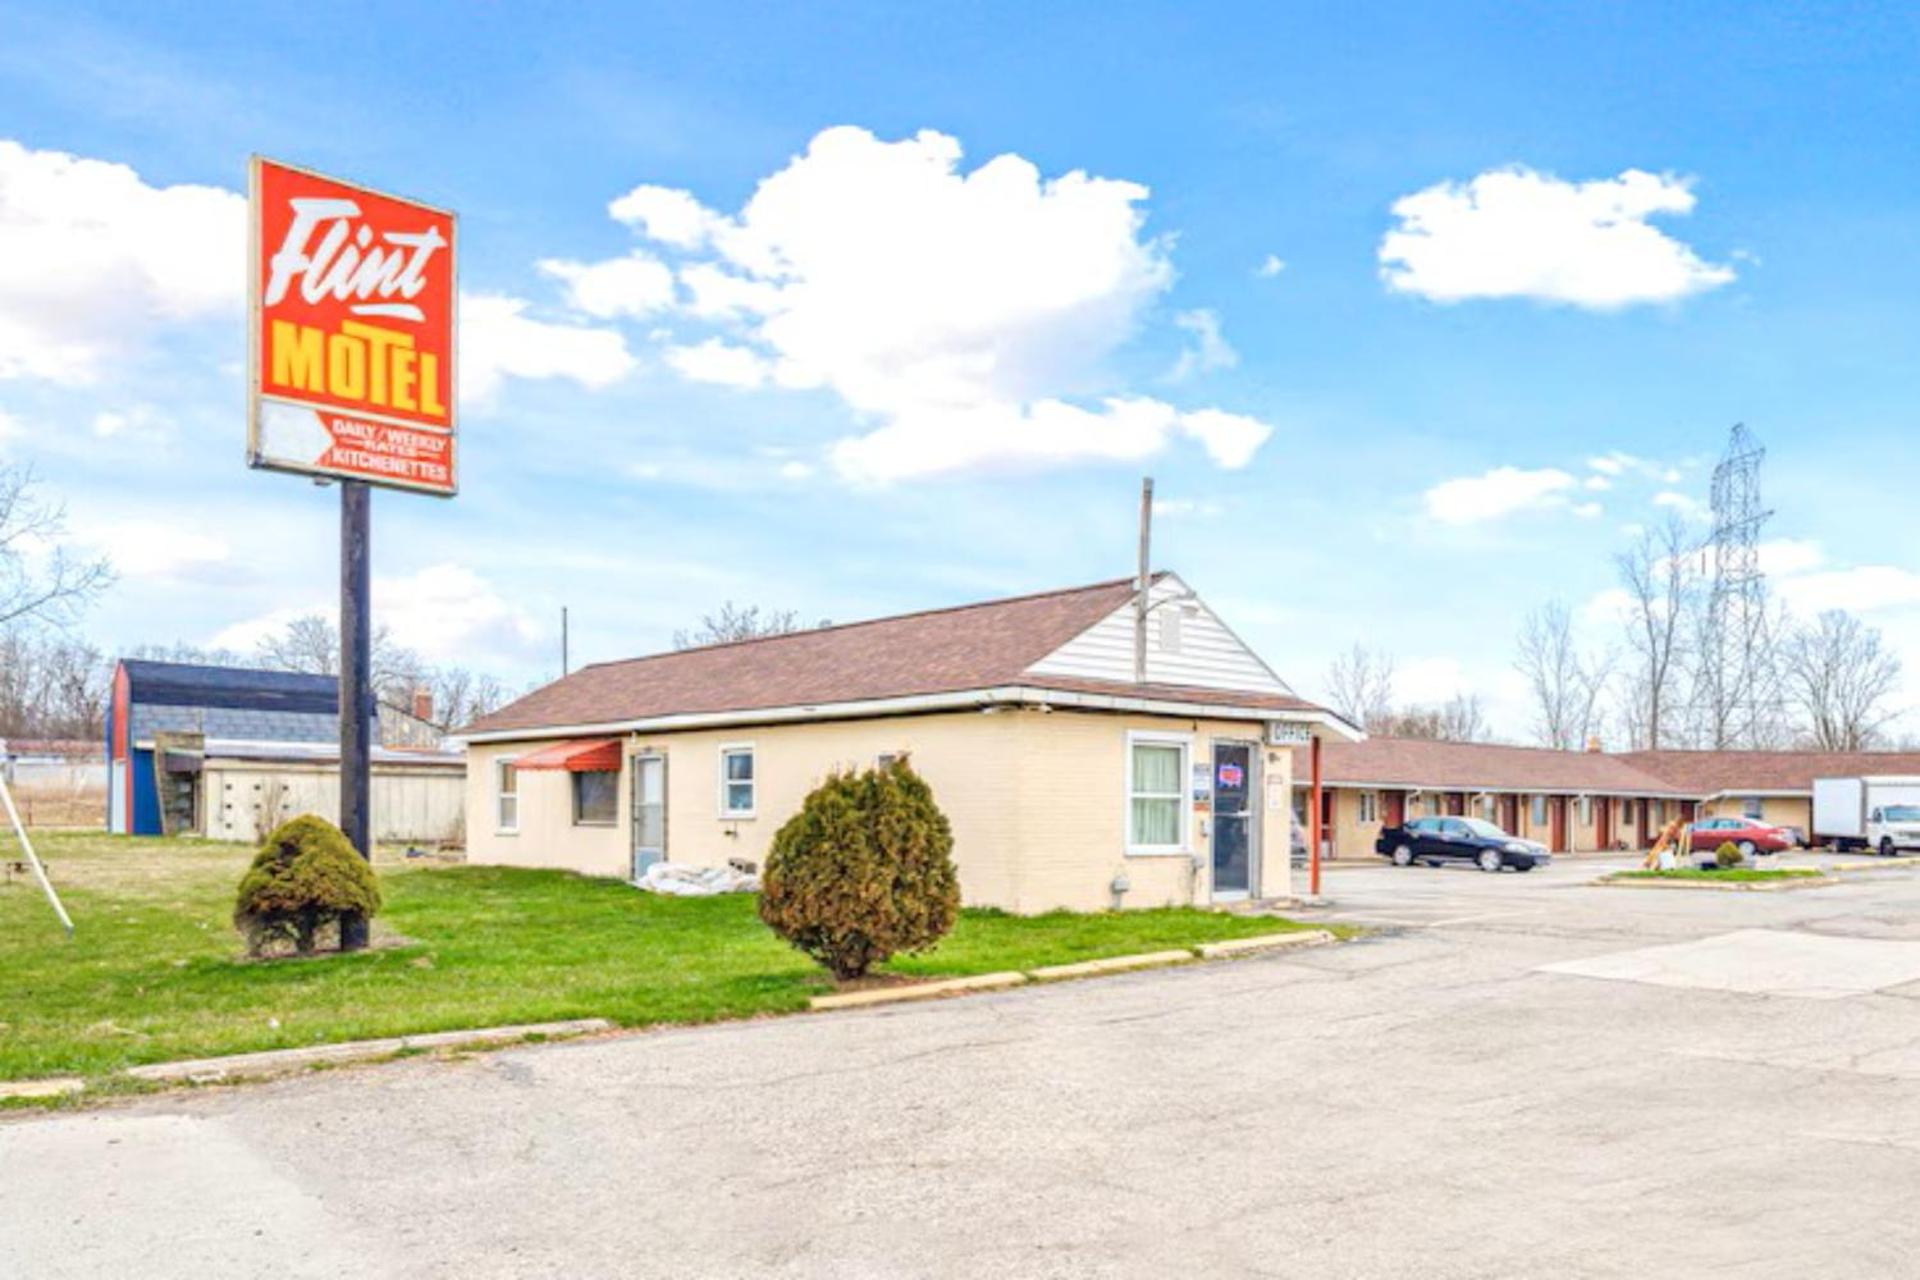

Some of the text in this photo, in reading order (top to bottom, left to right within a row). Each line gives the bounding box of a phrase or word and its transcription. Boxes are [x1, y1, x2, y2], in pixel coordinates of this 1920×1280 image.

[264, 197, 448, 306] Flint
[272, 319, 446, 416] MOTEL
[333, 418, 376, 440] DAILY
[332, 447, 447, 480] KITCHENETTES
